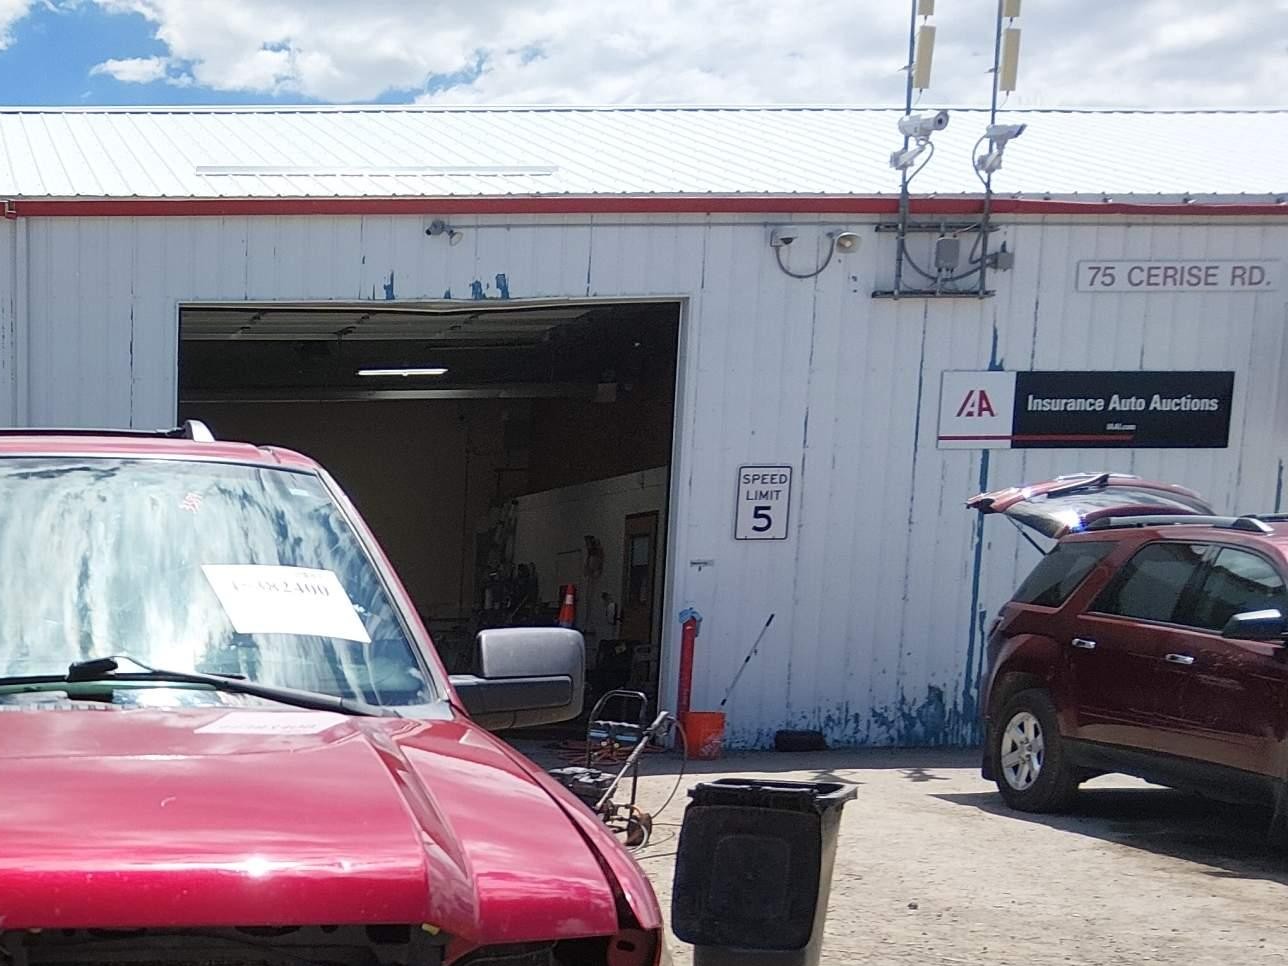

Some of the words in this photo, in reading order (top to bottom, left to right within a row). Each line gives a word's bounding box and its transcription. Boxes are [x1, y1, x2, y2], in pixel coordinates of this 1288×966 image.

[1087, 265, 1116, 287] 75
[1127, 265, 1219, 287] CERISE
[1230, 265, 1272, 287] RD.
[1027, 393, 1105, 412] Insurance
[1108, 394, 1146, 412] Auto
[1149, 394, 1219, 412] Auctions
[742, 473, 788, 485] SPEED
[745, 489, 782, 501] LIMIT
[751, 505, 773, 532] 5
